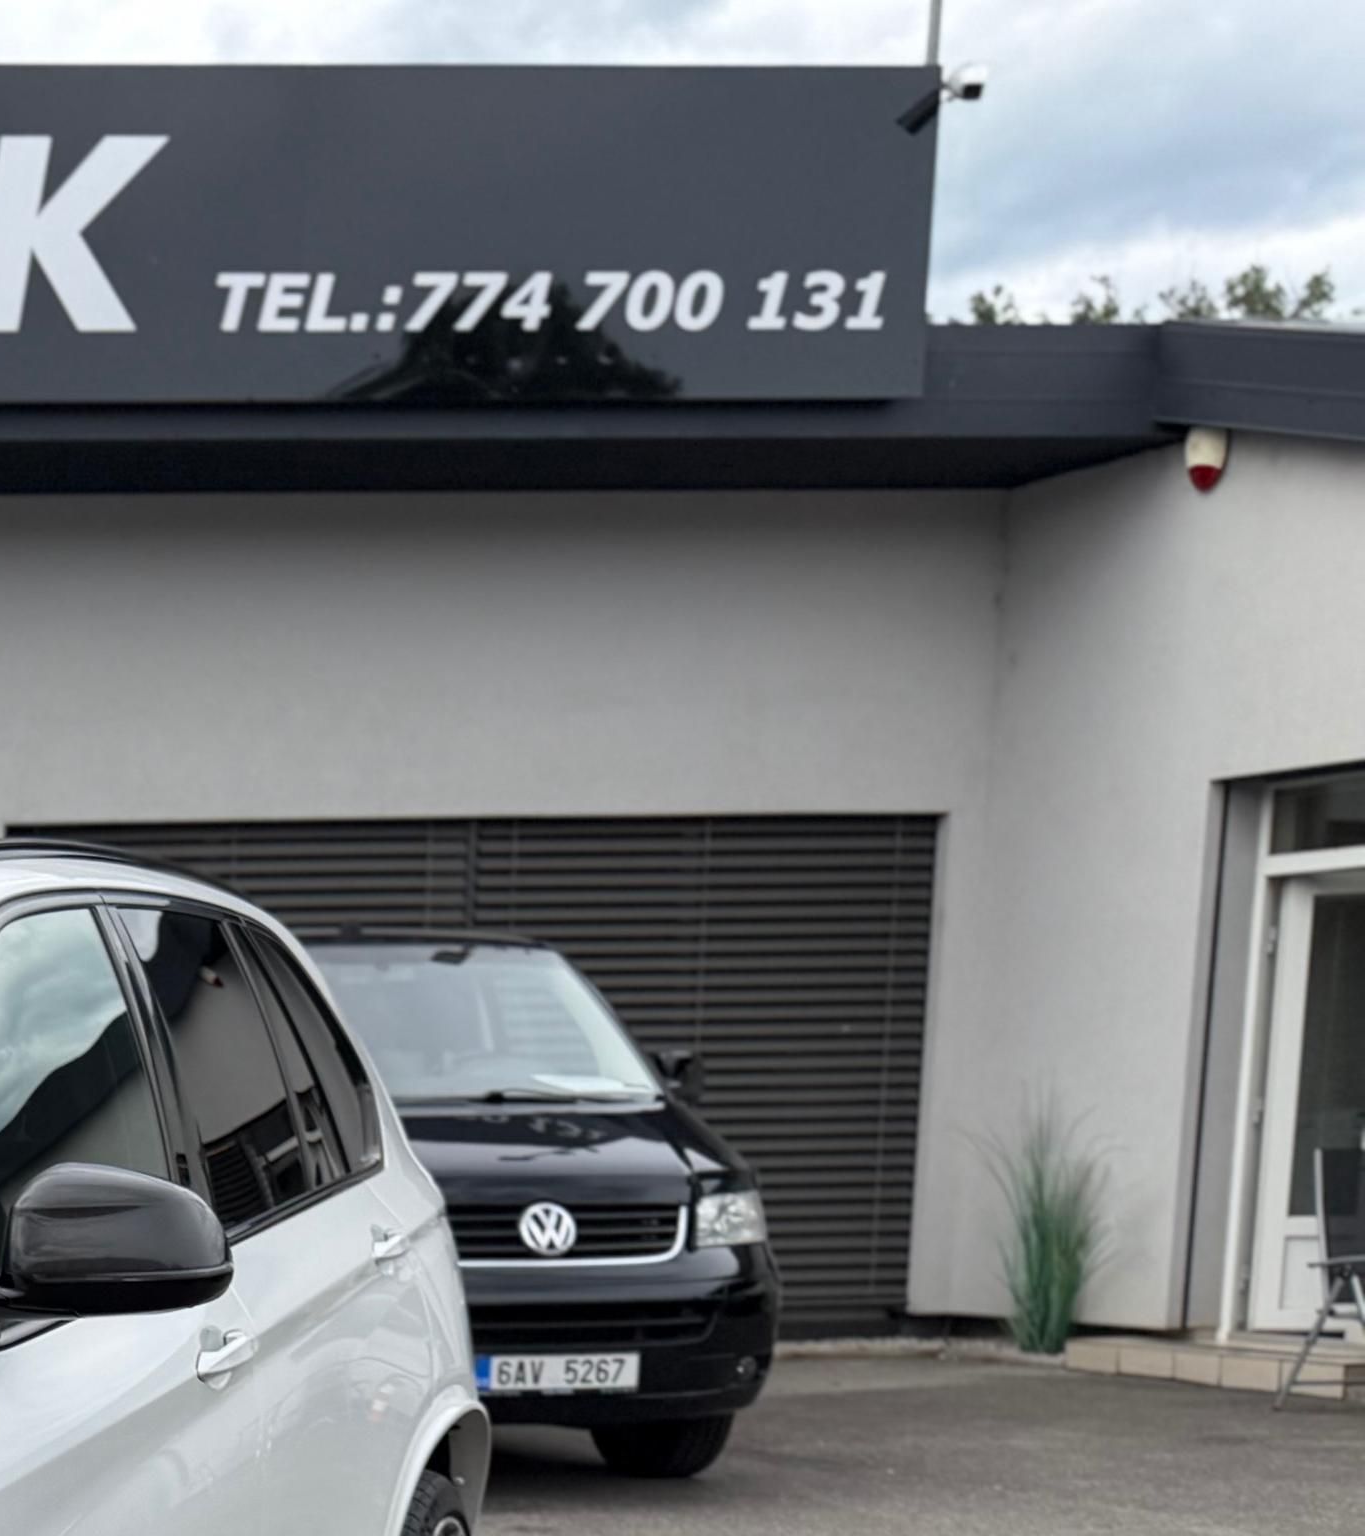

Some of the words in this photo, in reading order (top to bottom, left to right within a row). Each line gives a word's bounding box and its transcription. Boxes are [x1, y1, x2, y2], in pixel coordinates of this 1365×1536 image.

[576, 270, 725, 332] 700
[746, 270, 887, 332] 131
[496, 1360, 545, 1386] 6AV
[563, 1358, 626, 1384] 5267
